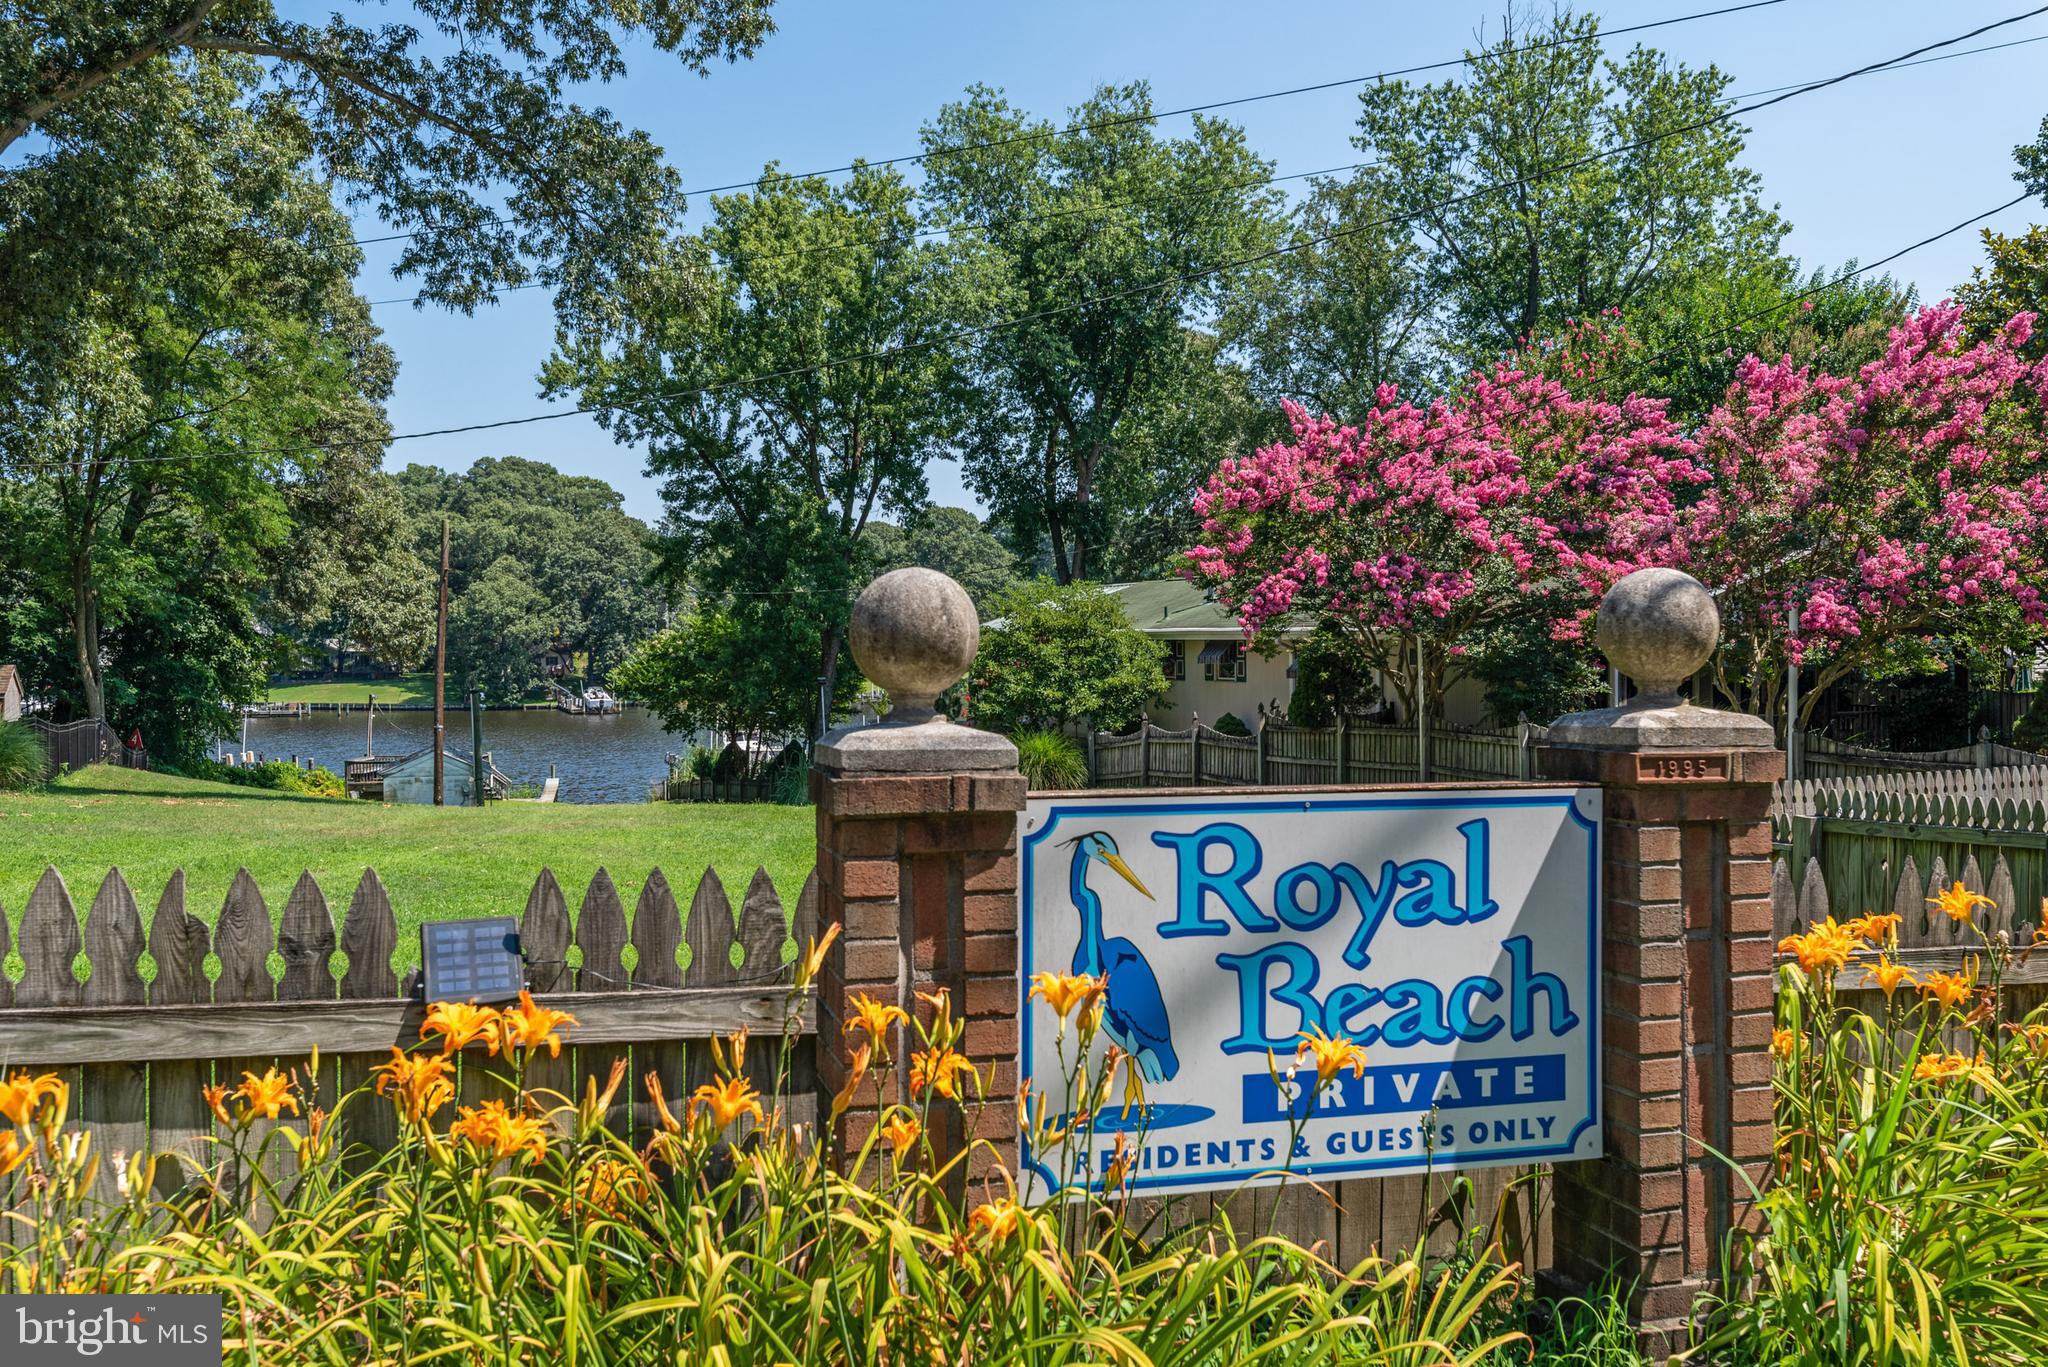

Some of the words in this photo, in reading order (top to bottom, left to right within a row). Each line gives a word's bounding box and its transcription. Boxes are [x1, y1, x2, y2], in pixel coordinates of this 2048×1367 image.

[1658, 760, 1707, 776] 1995
[1151, 818, 1499, 970] Royal
[1216, 935, 1579, 1055] Beach
[1277, 1065, 1535, 1112] PRIVATE
[1291, 1135, 1311, 1159] &
[1326, 1124, 1454, 1155] GUESTS
[1468, 1116, 1556, 1143] ONLY
